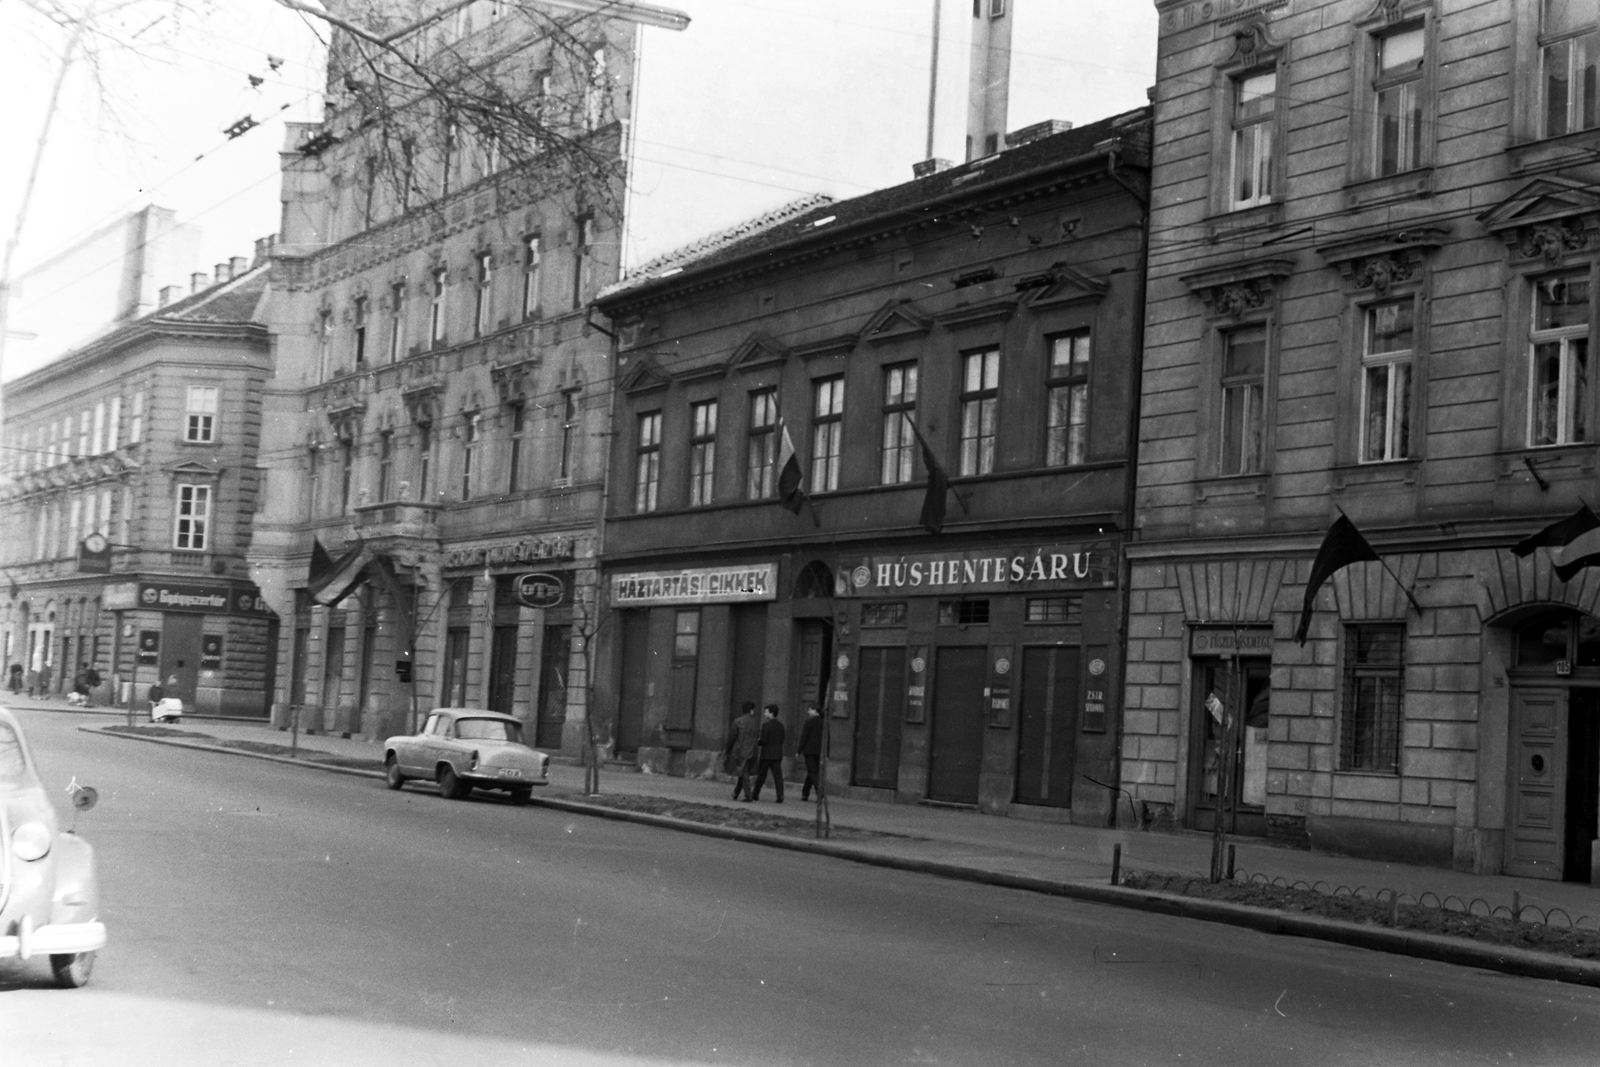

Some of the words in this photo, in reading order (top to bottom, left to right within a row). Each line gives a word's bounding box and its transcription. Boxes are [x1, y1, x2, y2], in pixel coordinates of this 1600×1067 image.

[876, 548, 1092, 587] HÚS-HENTESÁRU
[618, 572, 706, 600] HÁZTARTÁSI
[709, 570, 769, 595] CIKKEK
[1557, 661, 1570, 672] 105
